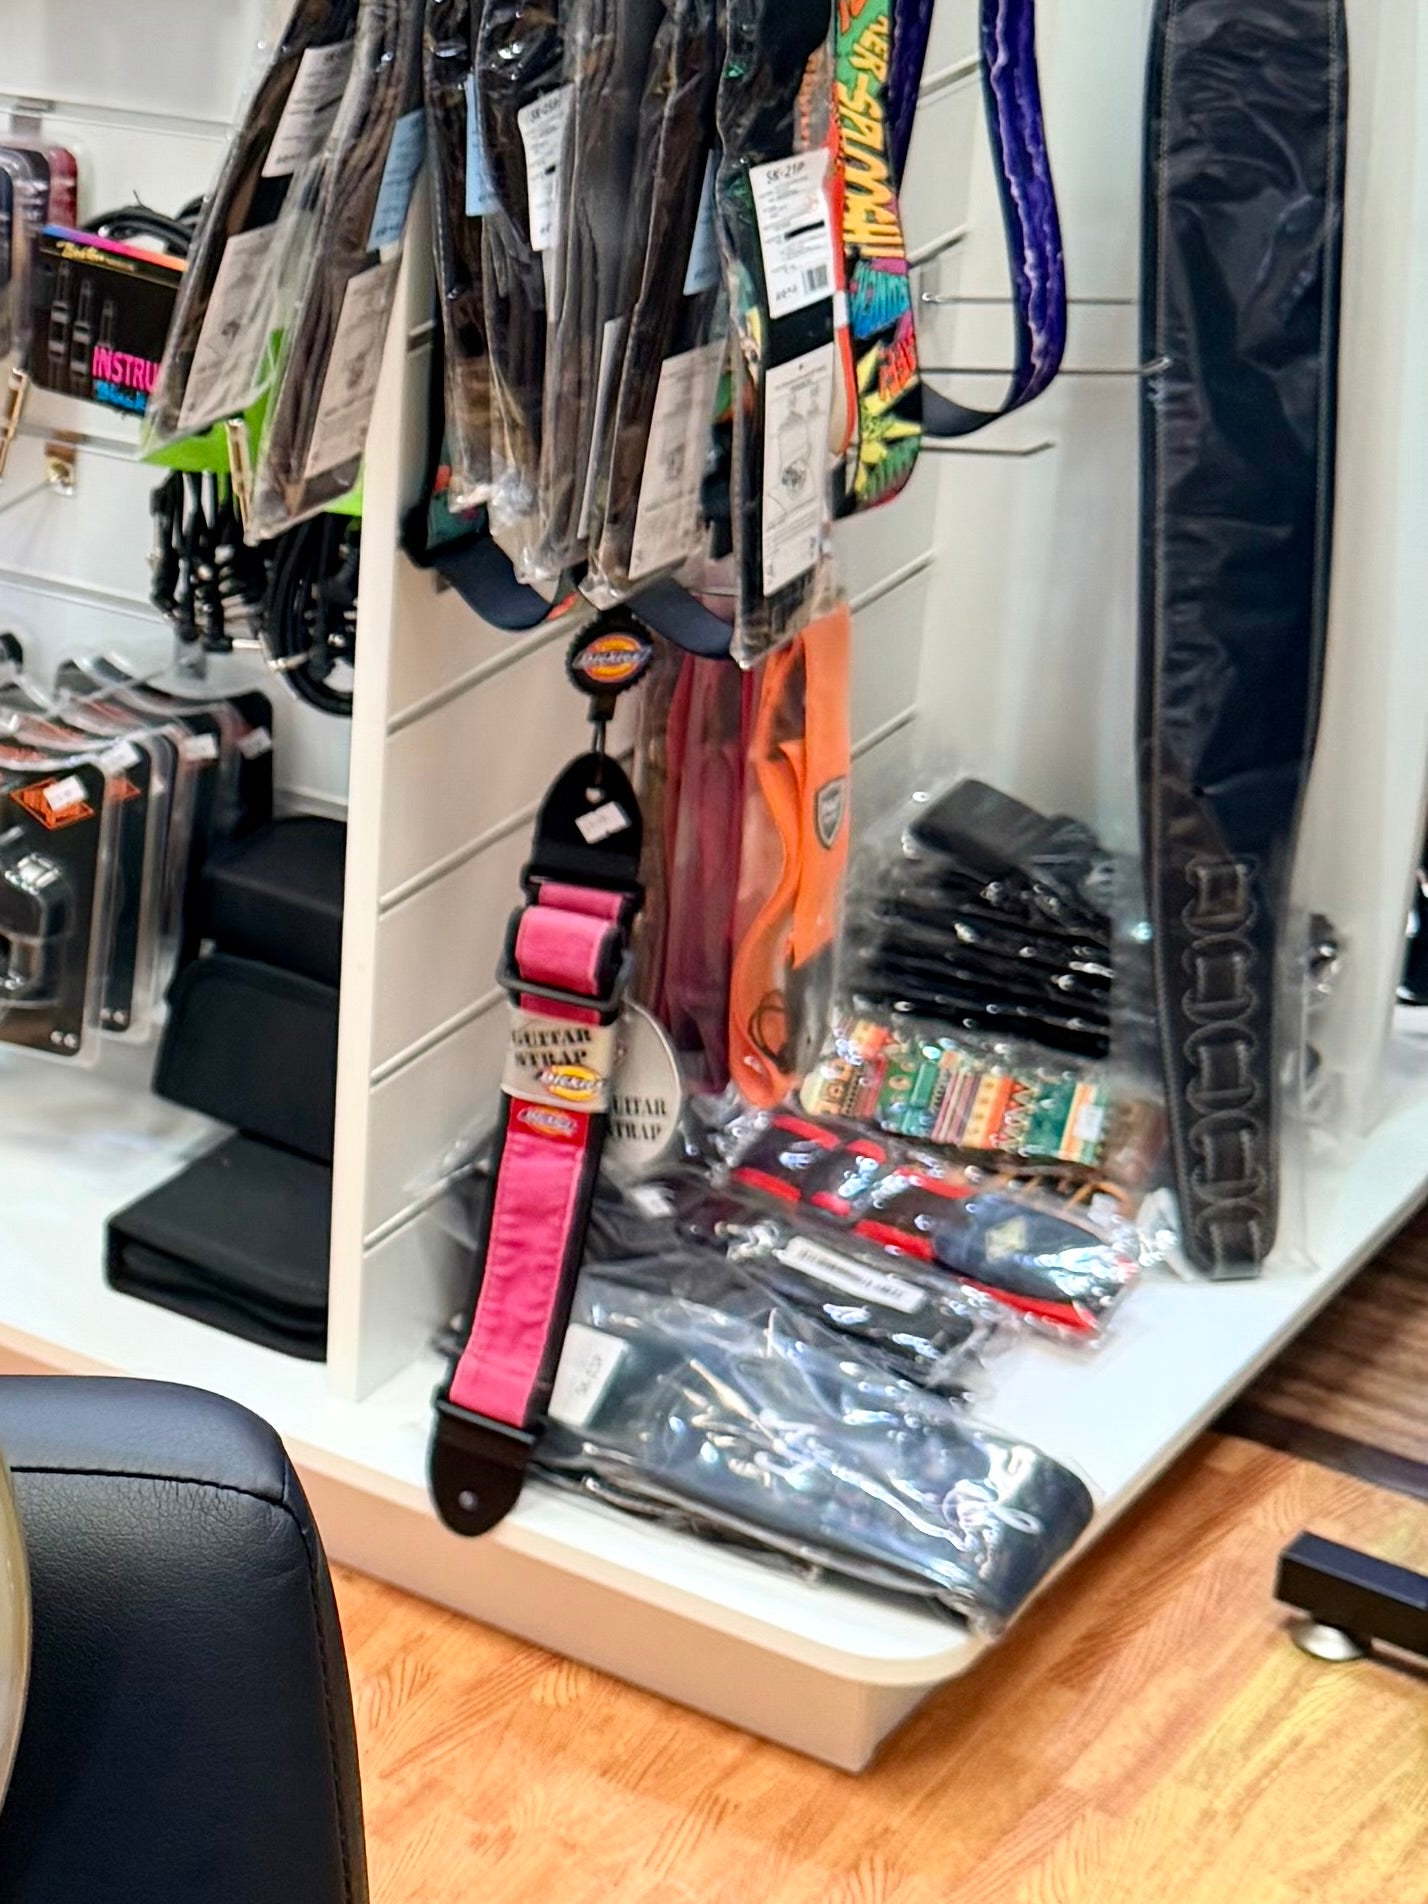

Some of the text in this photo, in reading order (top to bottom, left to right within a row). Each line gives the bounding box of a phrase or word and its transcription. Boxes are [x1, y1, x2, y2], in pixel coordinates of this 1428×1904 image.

[93, 345, 161, 394] INSTRU
[512, 1027, 592, 1046] GUITAR
[515, 1049, 588, 1067] STRAP
[611, 1095, 667, 1116] UITAR
